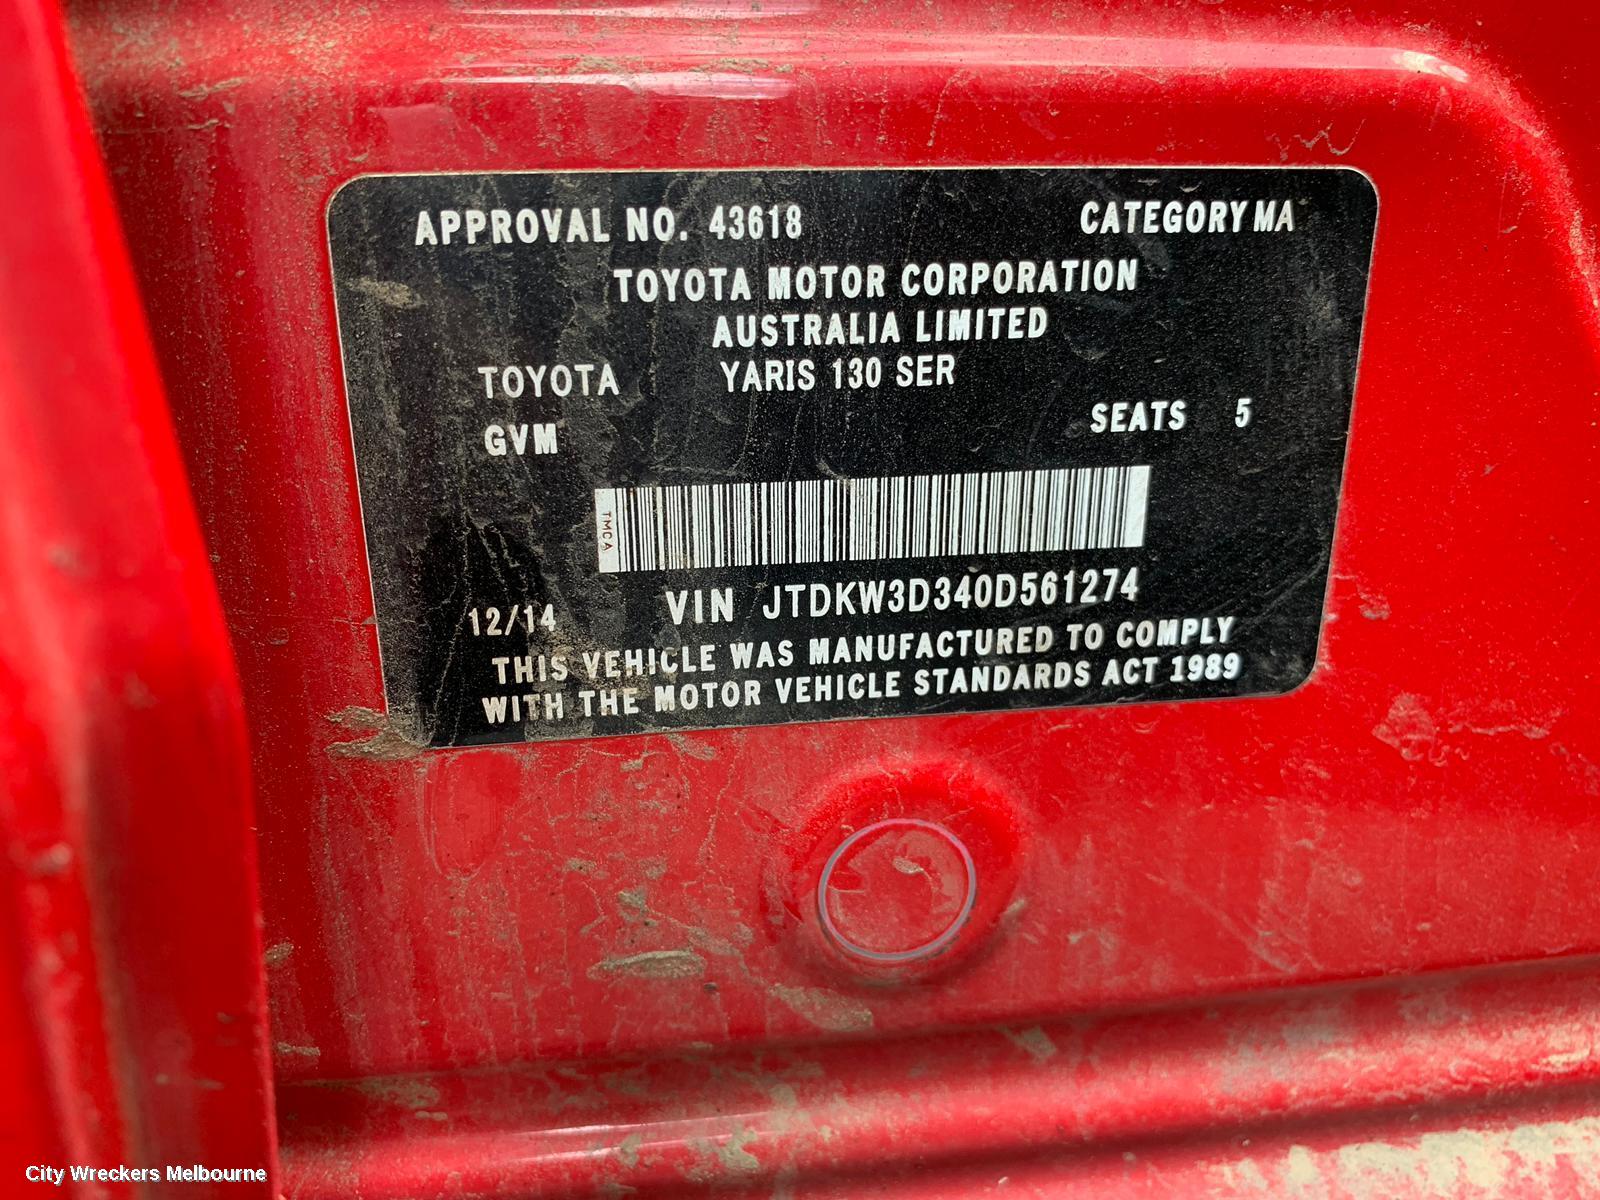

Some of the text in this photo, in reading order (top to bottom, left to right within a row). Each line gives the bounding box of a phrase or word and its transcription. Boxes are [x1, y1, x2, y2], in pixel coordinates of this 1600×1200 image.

[415, 204, 802, 246] APPROVAL NO. 43618
[1080, 200, 1295, 235] CATEGORY MA
[613, 258, 1139, 303] TOYOTA MOTOR CORPORATION
[712, 306, 1049, 348] AUSTRALIA LIMITED
[477, 363, 620, 399] TOYOTA
[720, 354, 955, 393] YARIS 130 SER
[1090, 398, 1251, 434] SEATS 5
[484, 422, 558, 456] GVM
[602, 511, 613, 551] TMCA
[665, 566, 1139, 625] VIN JTDKW3D340D561274
[468, 603, 557, 636] 12/14
[492, 616, 1237, 686] THIS VEHICLE WAS MANUFACTURED TO COMPLY
[482, 652, 1242, 725] WITH THE MOTOR VEHICLE STANDARDS ACT 1989
